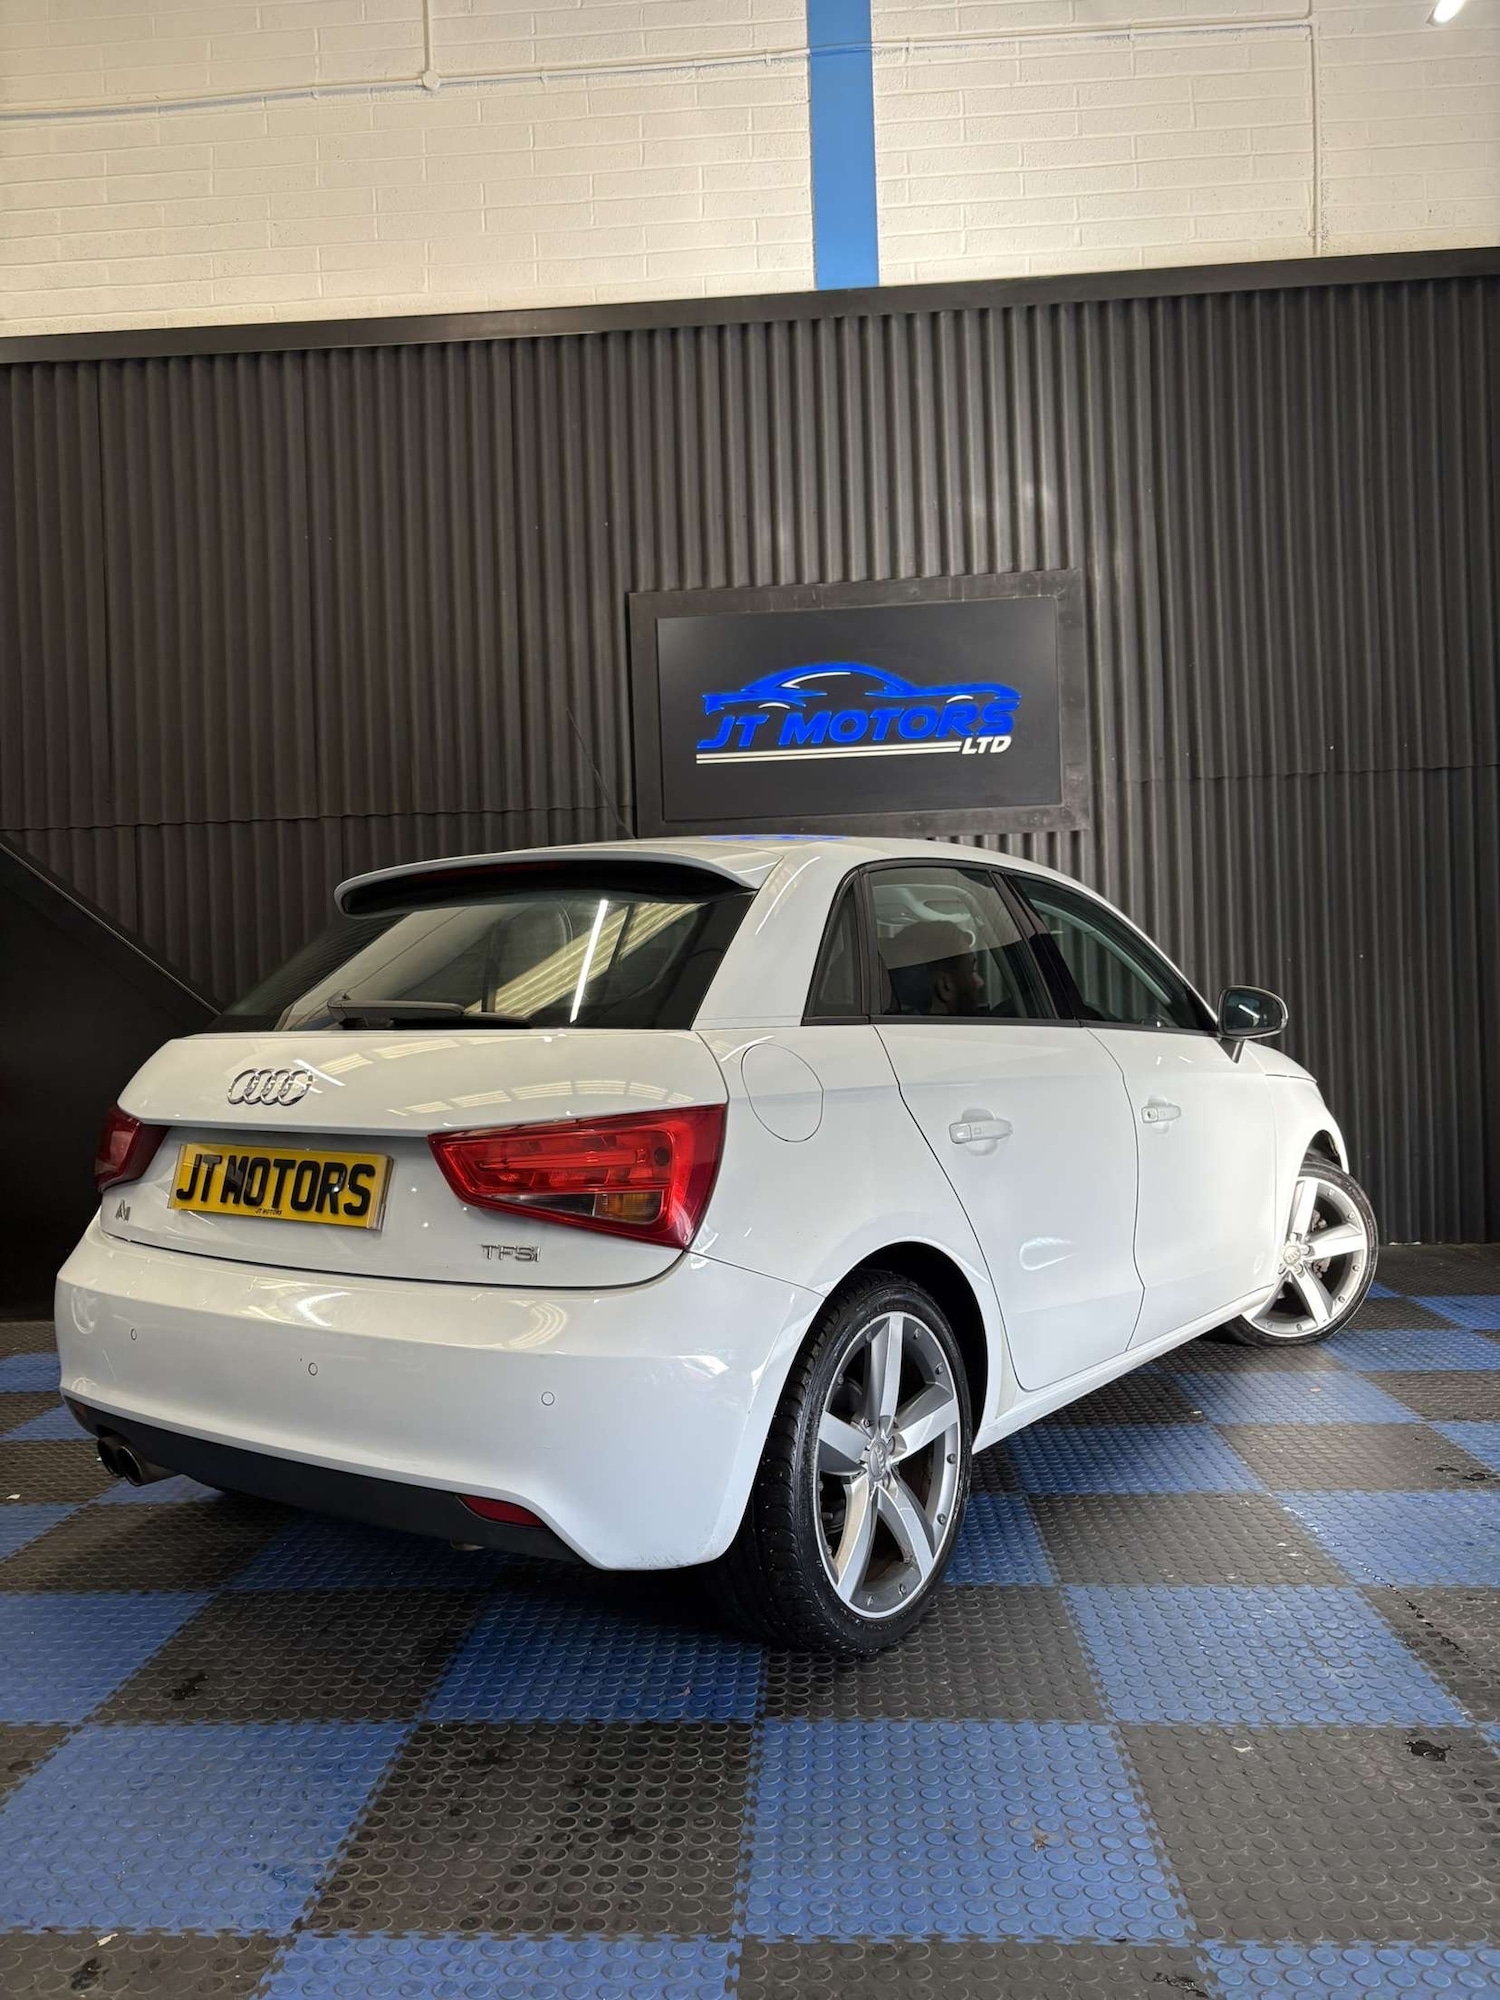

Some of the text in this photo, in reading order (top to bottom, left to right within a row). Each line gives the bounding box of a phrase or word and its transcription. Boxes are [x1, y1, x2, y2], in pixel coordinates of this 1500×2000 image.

[697, 702, 1016, 749] JT MOTORS
[961, 735, 1012, 755] LTD
[176, 1153, 376, 1217] JT MOTORS
[481, 1244, 541, 1262] TFSI
